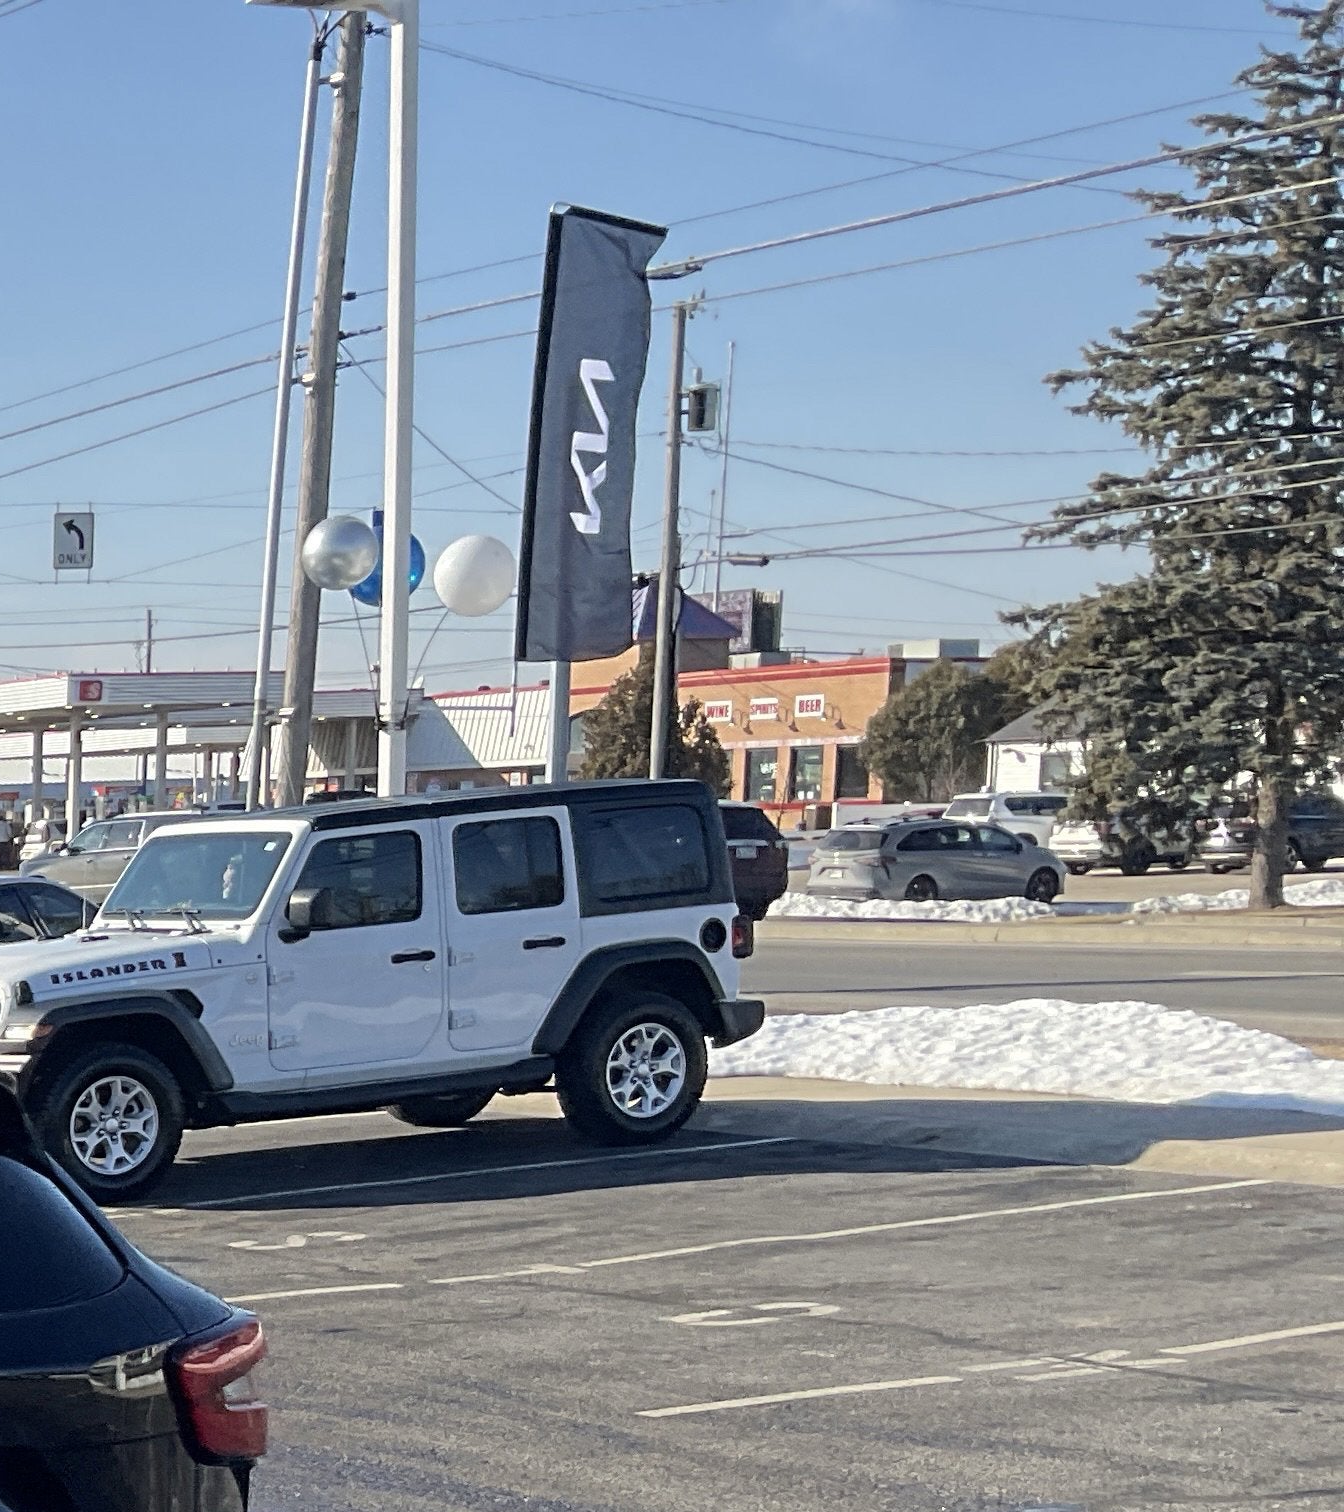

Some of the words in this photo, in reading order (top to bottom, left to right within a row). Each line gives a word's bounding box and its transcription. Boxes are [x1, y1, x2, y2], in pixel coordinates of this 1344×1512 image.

[58, 553, 87, 564] ONLY
[706, 704, 730, 719] WINE
[798, 698, 822, 714] BEER
[49, 958, 168, 985] ISLANDER
[229, 1032, 265, 1048] Jeep
